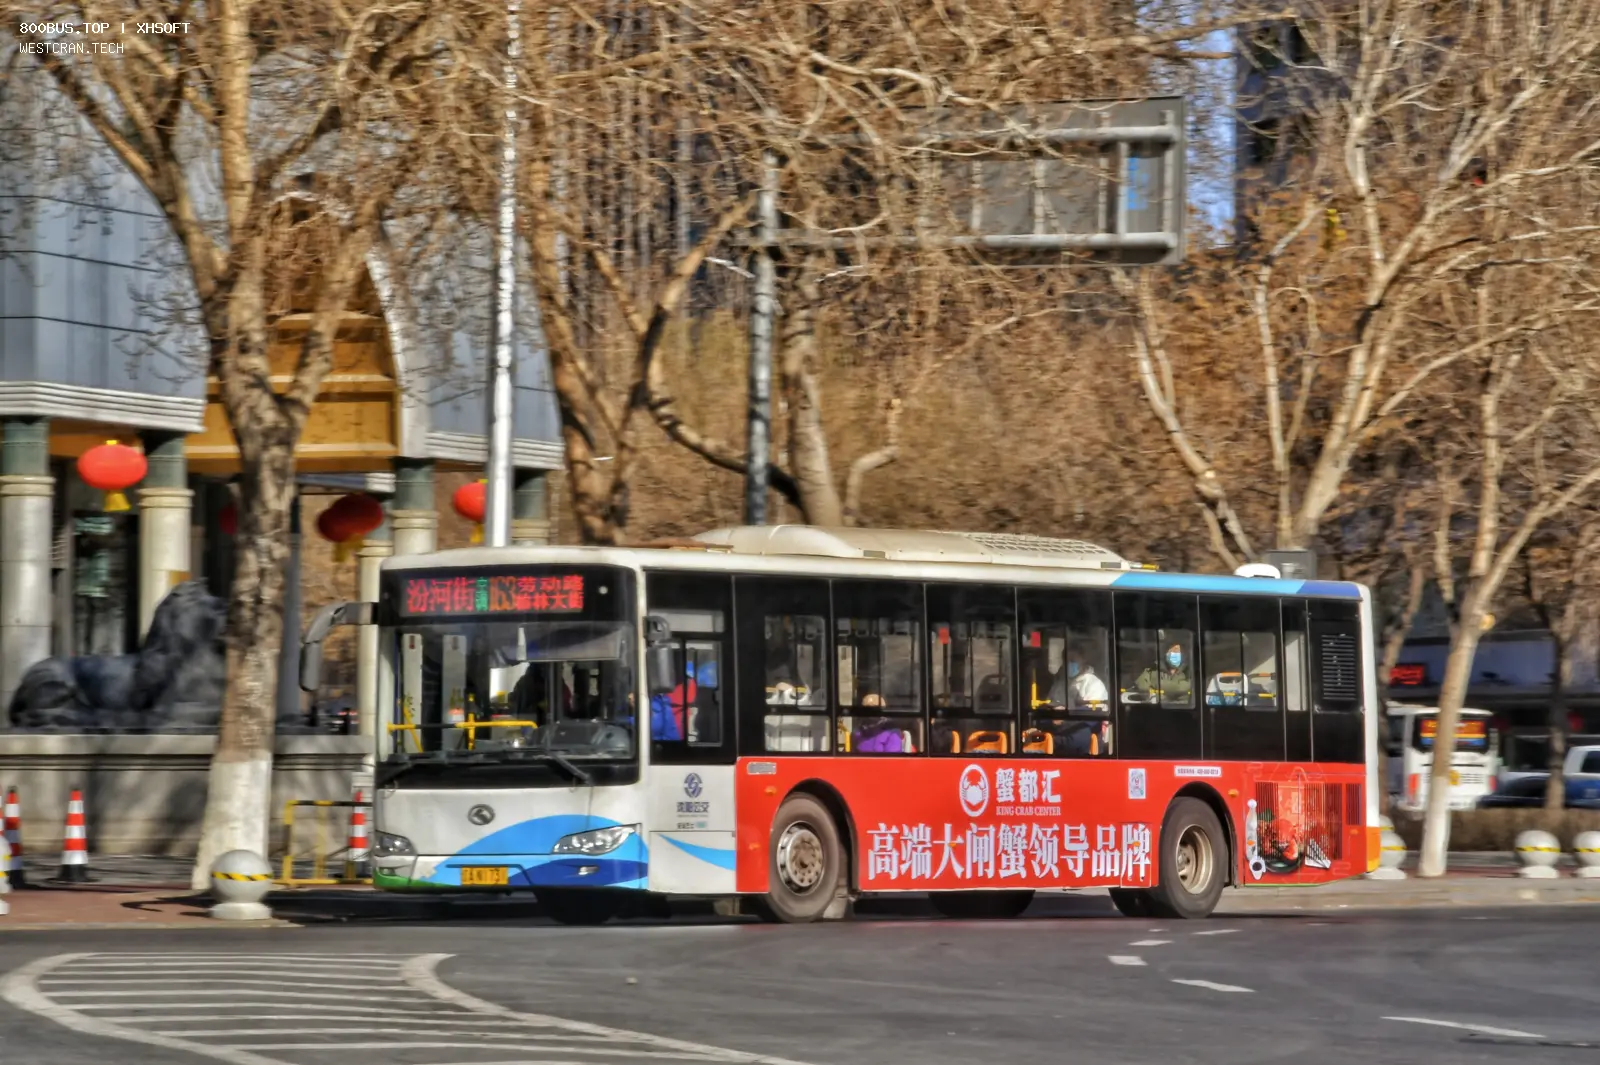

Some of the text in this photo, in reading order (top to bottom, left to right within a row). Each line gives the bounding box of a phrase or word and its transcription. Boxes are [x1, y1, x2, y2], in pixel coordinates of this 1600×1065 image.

[407, 577, 475, 612] 汾河街
[489, 575, 516, 611] 163
[995, 768, 1062, 803] 蟹都汇
[996, 806, 1062, 816] KING CRAB CENTER
[866, 821, 1152, 882] 高端大闸蟹领导品牌
